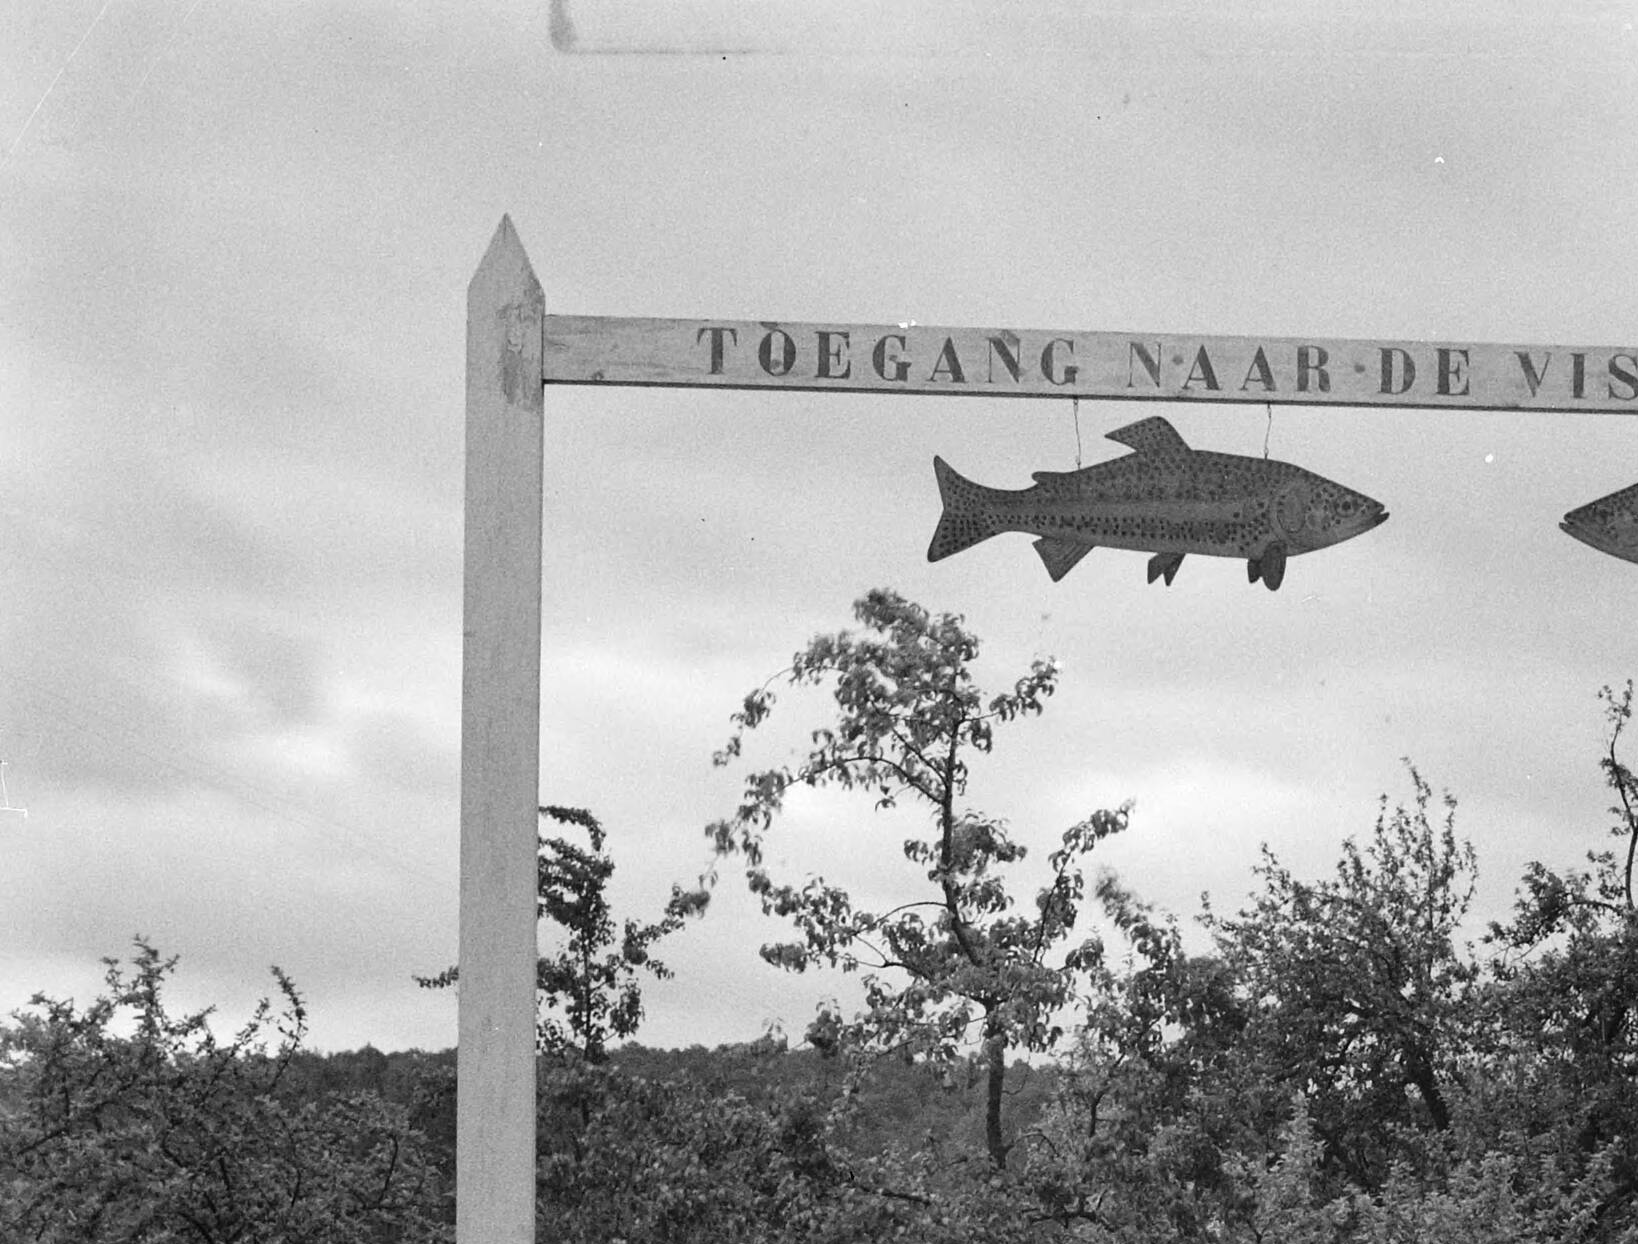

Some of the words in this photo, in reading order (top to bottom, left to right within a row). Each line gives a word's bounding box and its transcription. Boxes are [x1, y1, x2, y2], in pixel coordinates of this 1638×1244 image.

[697, 326, 1078, 386] TOEGANG
[1127, 342, 1331, 393] NAAR
[1378, 347, 1469, 395] DE
